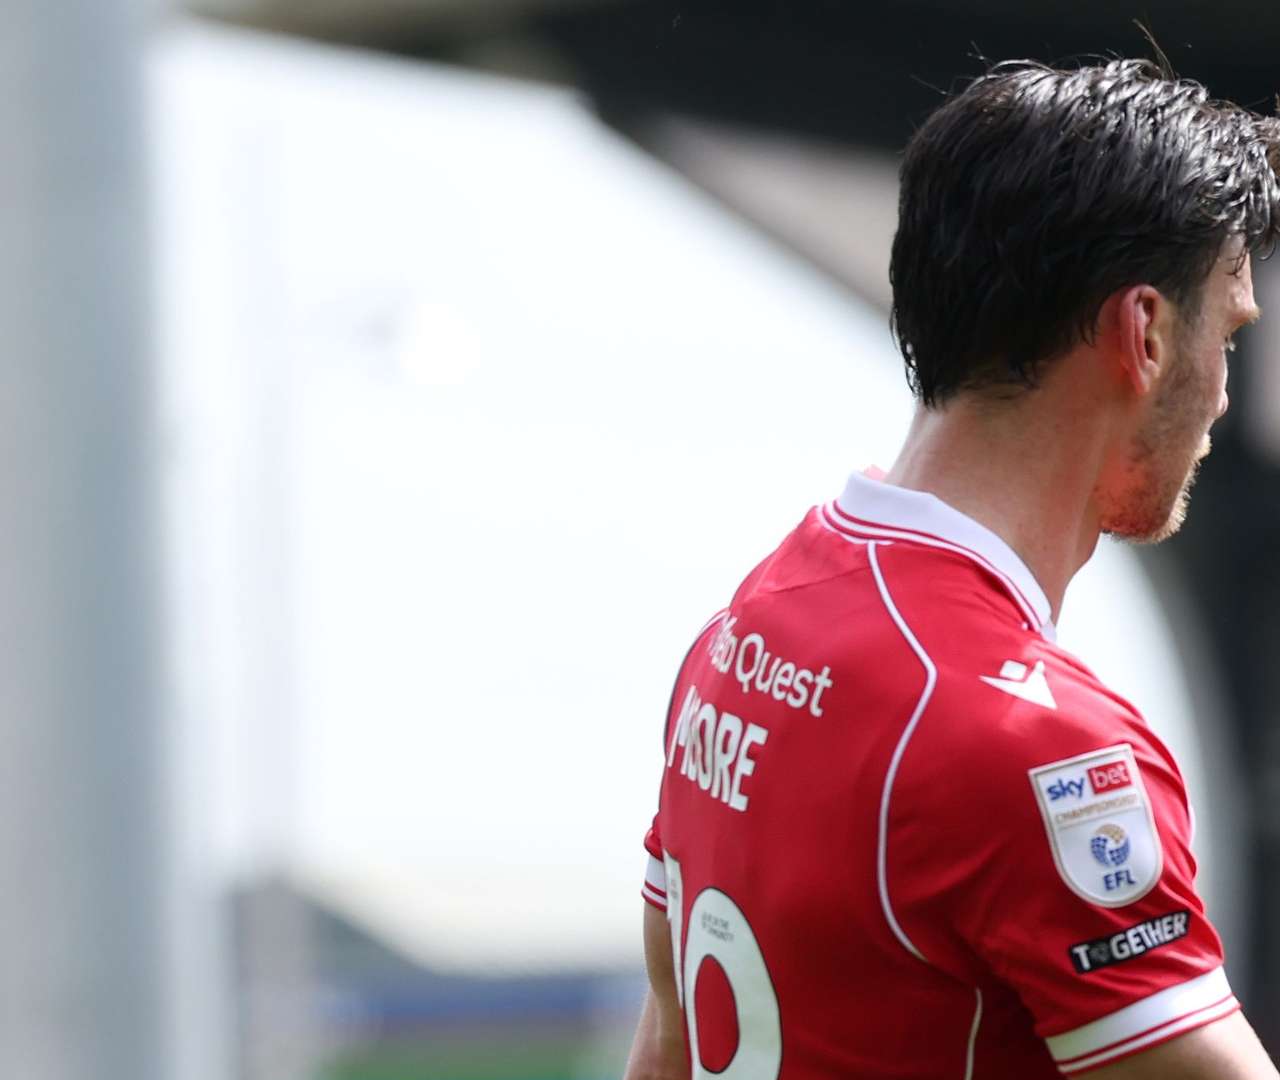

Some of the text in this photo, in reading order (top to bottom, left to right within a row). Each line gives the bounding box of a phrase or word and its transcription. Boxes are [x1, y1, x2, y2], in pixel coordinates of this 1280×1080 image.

[735, 632, 833, 718] Quest
[1046, 763, 1130, 801] sky bet
[1103, 869, 1137, 891] EFL
